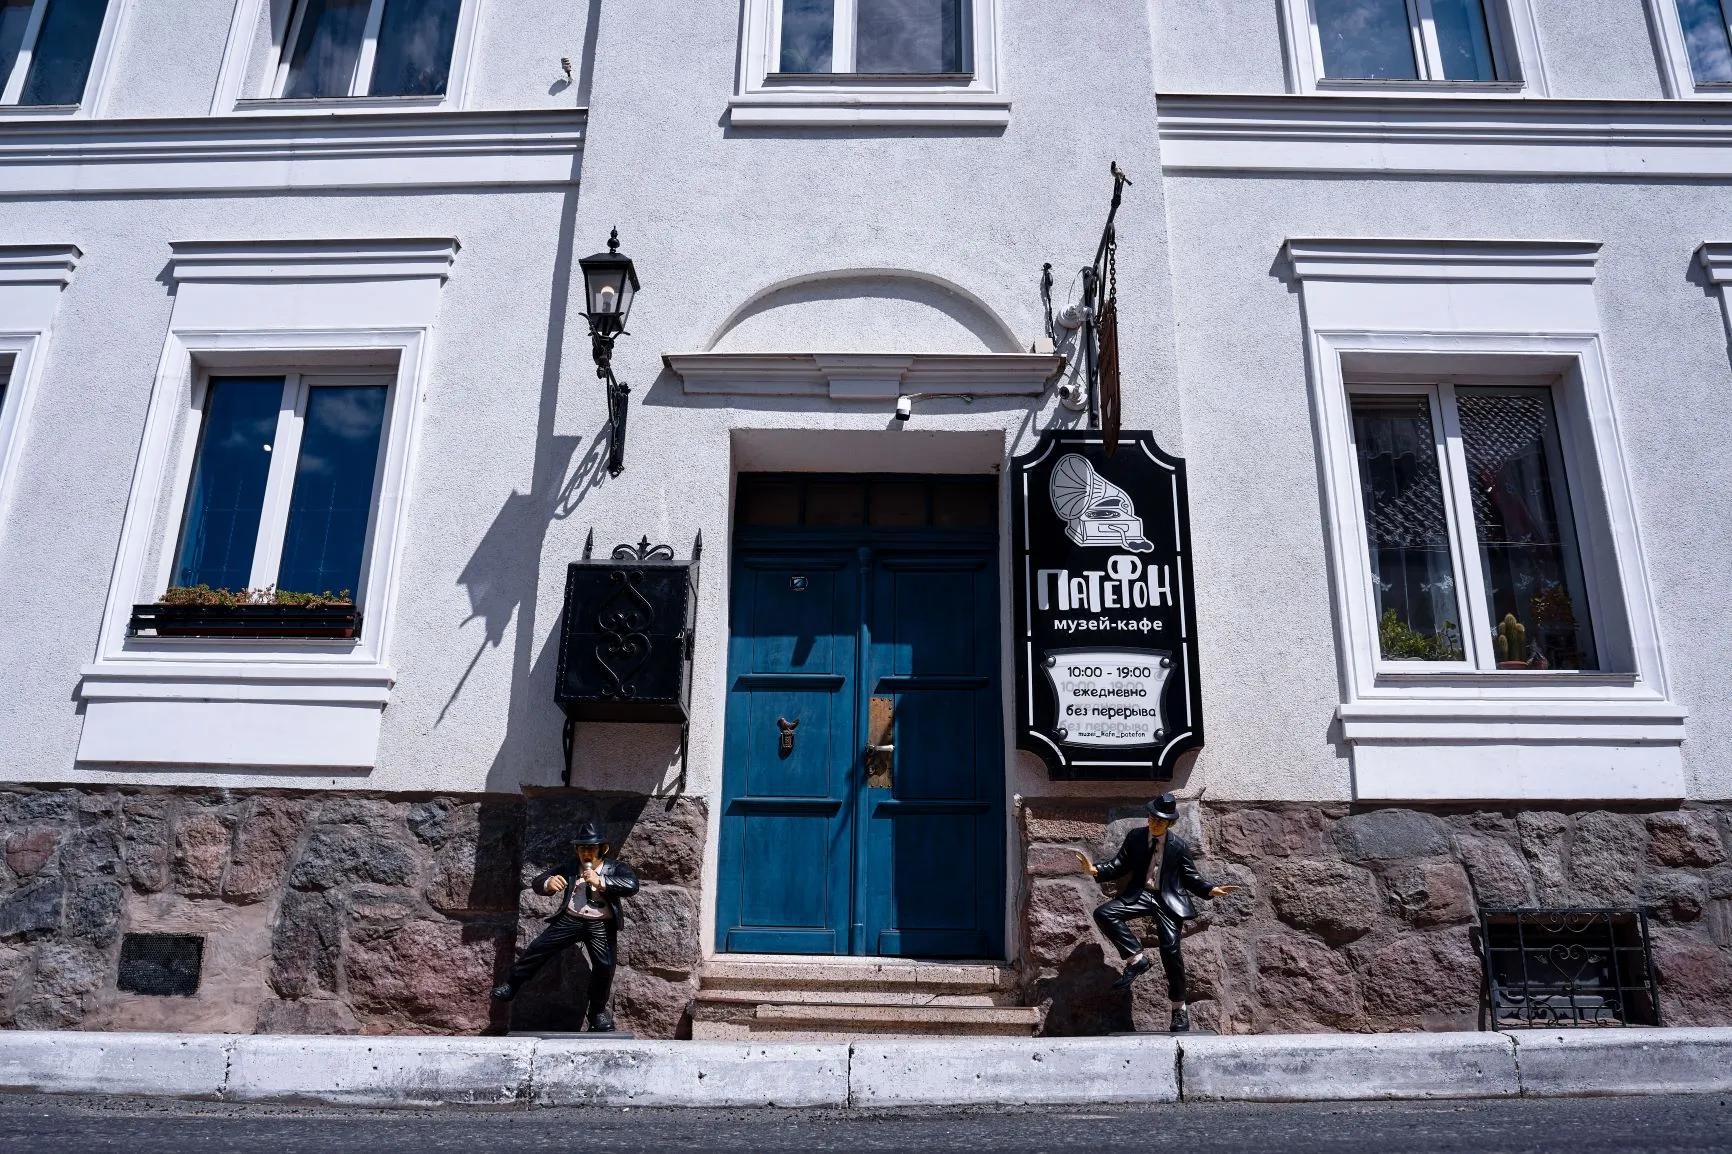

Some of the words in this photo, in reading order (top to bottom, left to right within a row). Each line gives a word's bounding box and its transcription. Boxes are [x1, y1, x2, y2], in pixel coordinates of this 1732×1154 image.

[1037, 555, 1173, 612] ПАТЕФОН
[1054, 616, 1163, 634] музей-кафе
[1067, 666, 1103, 678] 10:00
[1116, 666, 1151, 679] 19:00
[1073, 688, 1147, 698] ежедневно
[1066, 704, 1088, 716] без
[1092, 707, 1156, 720] перерыва
